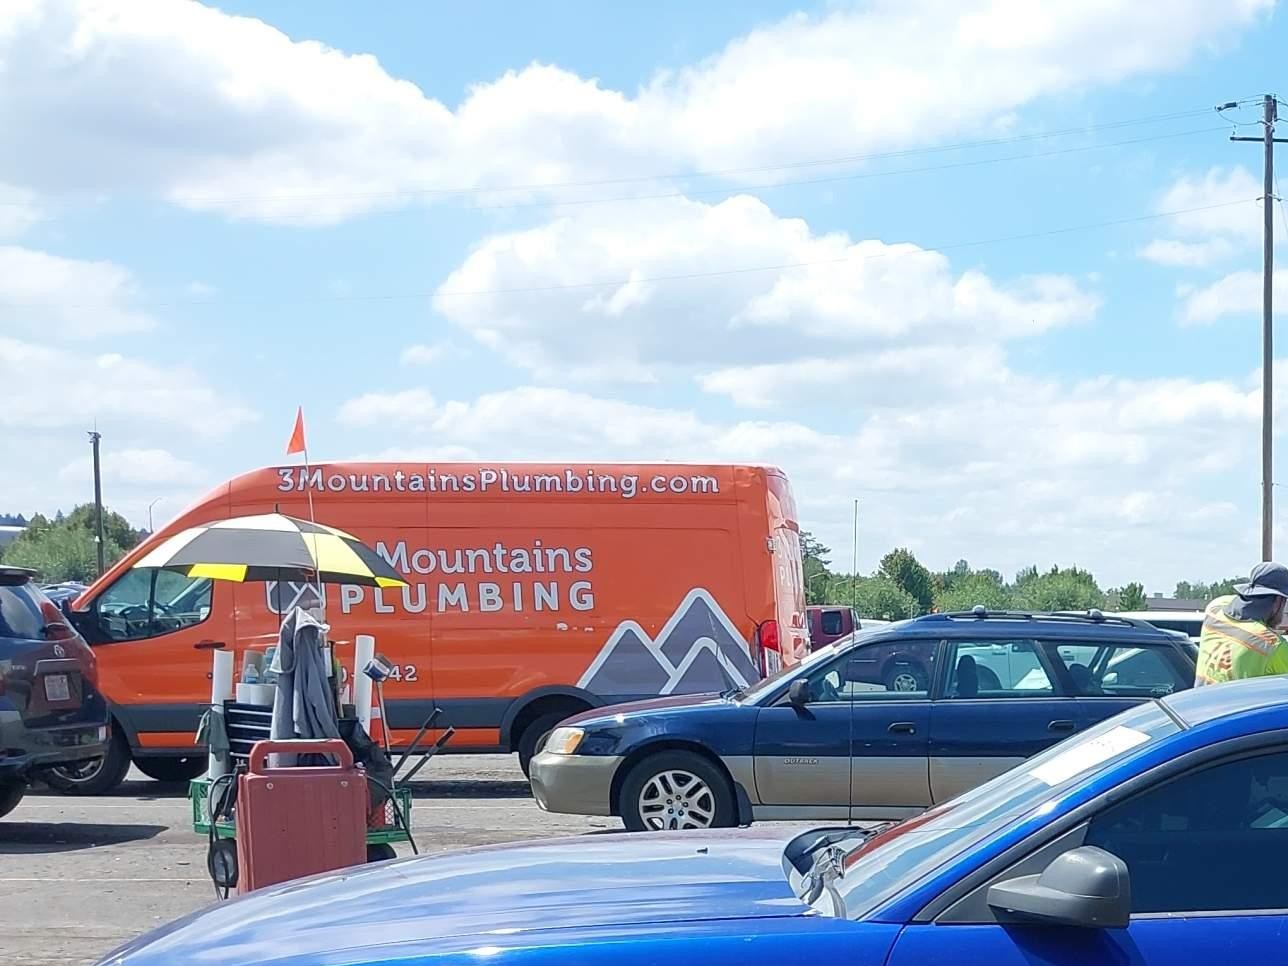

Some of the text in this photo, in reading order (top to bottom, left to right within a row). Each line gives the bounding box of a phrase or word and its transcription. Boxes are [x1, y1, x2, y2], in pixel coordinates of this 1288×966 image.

[278, 467, 720, 498] 3MountainsPlumbing.com
[376, 541, 594, 574] Mountains
[341, 581, 596, 614] PLUMBING
